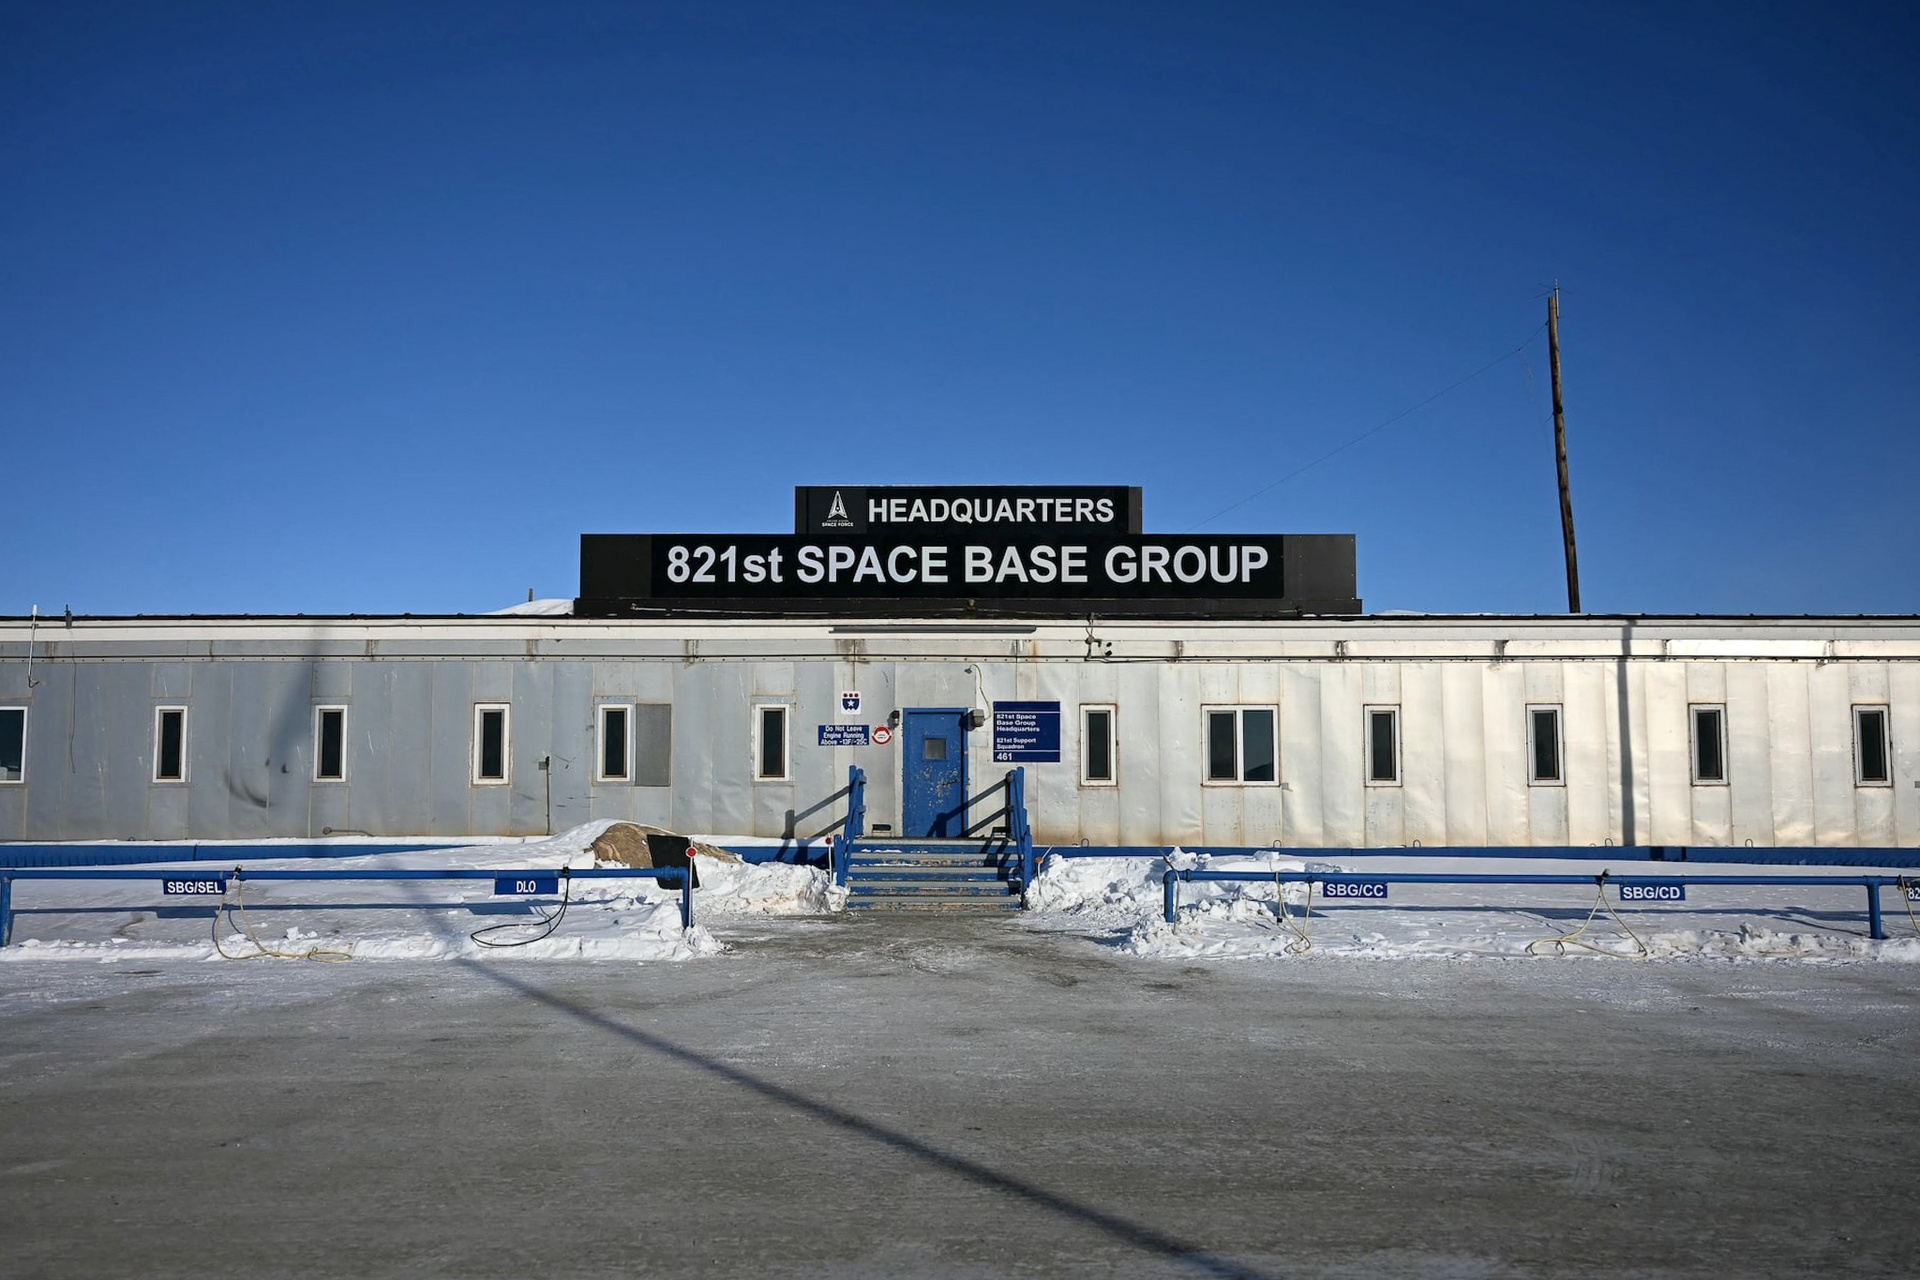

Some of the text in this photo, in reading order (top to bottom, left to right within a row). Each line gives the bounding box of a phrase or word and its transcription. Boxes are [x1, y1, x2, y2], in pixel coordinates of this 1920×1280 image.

[868, 498, 1114, 523] HEADQUARTERS
[666, 545, 1269, 583] 821st SPACE BASE GROUP
[843, 732, 864, 740] Running
[996, 752, 1013, 761] 461
[167, 881, 223, 894] SBG/SEL
[516, 880, 537, 893] DLO
[1326, 883, 1384, 897] SBG/CC
[1622, 886, 1680, 899] SBG/CD
